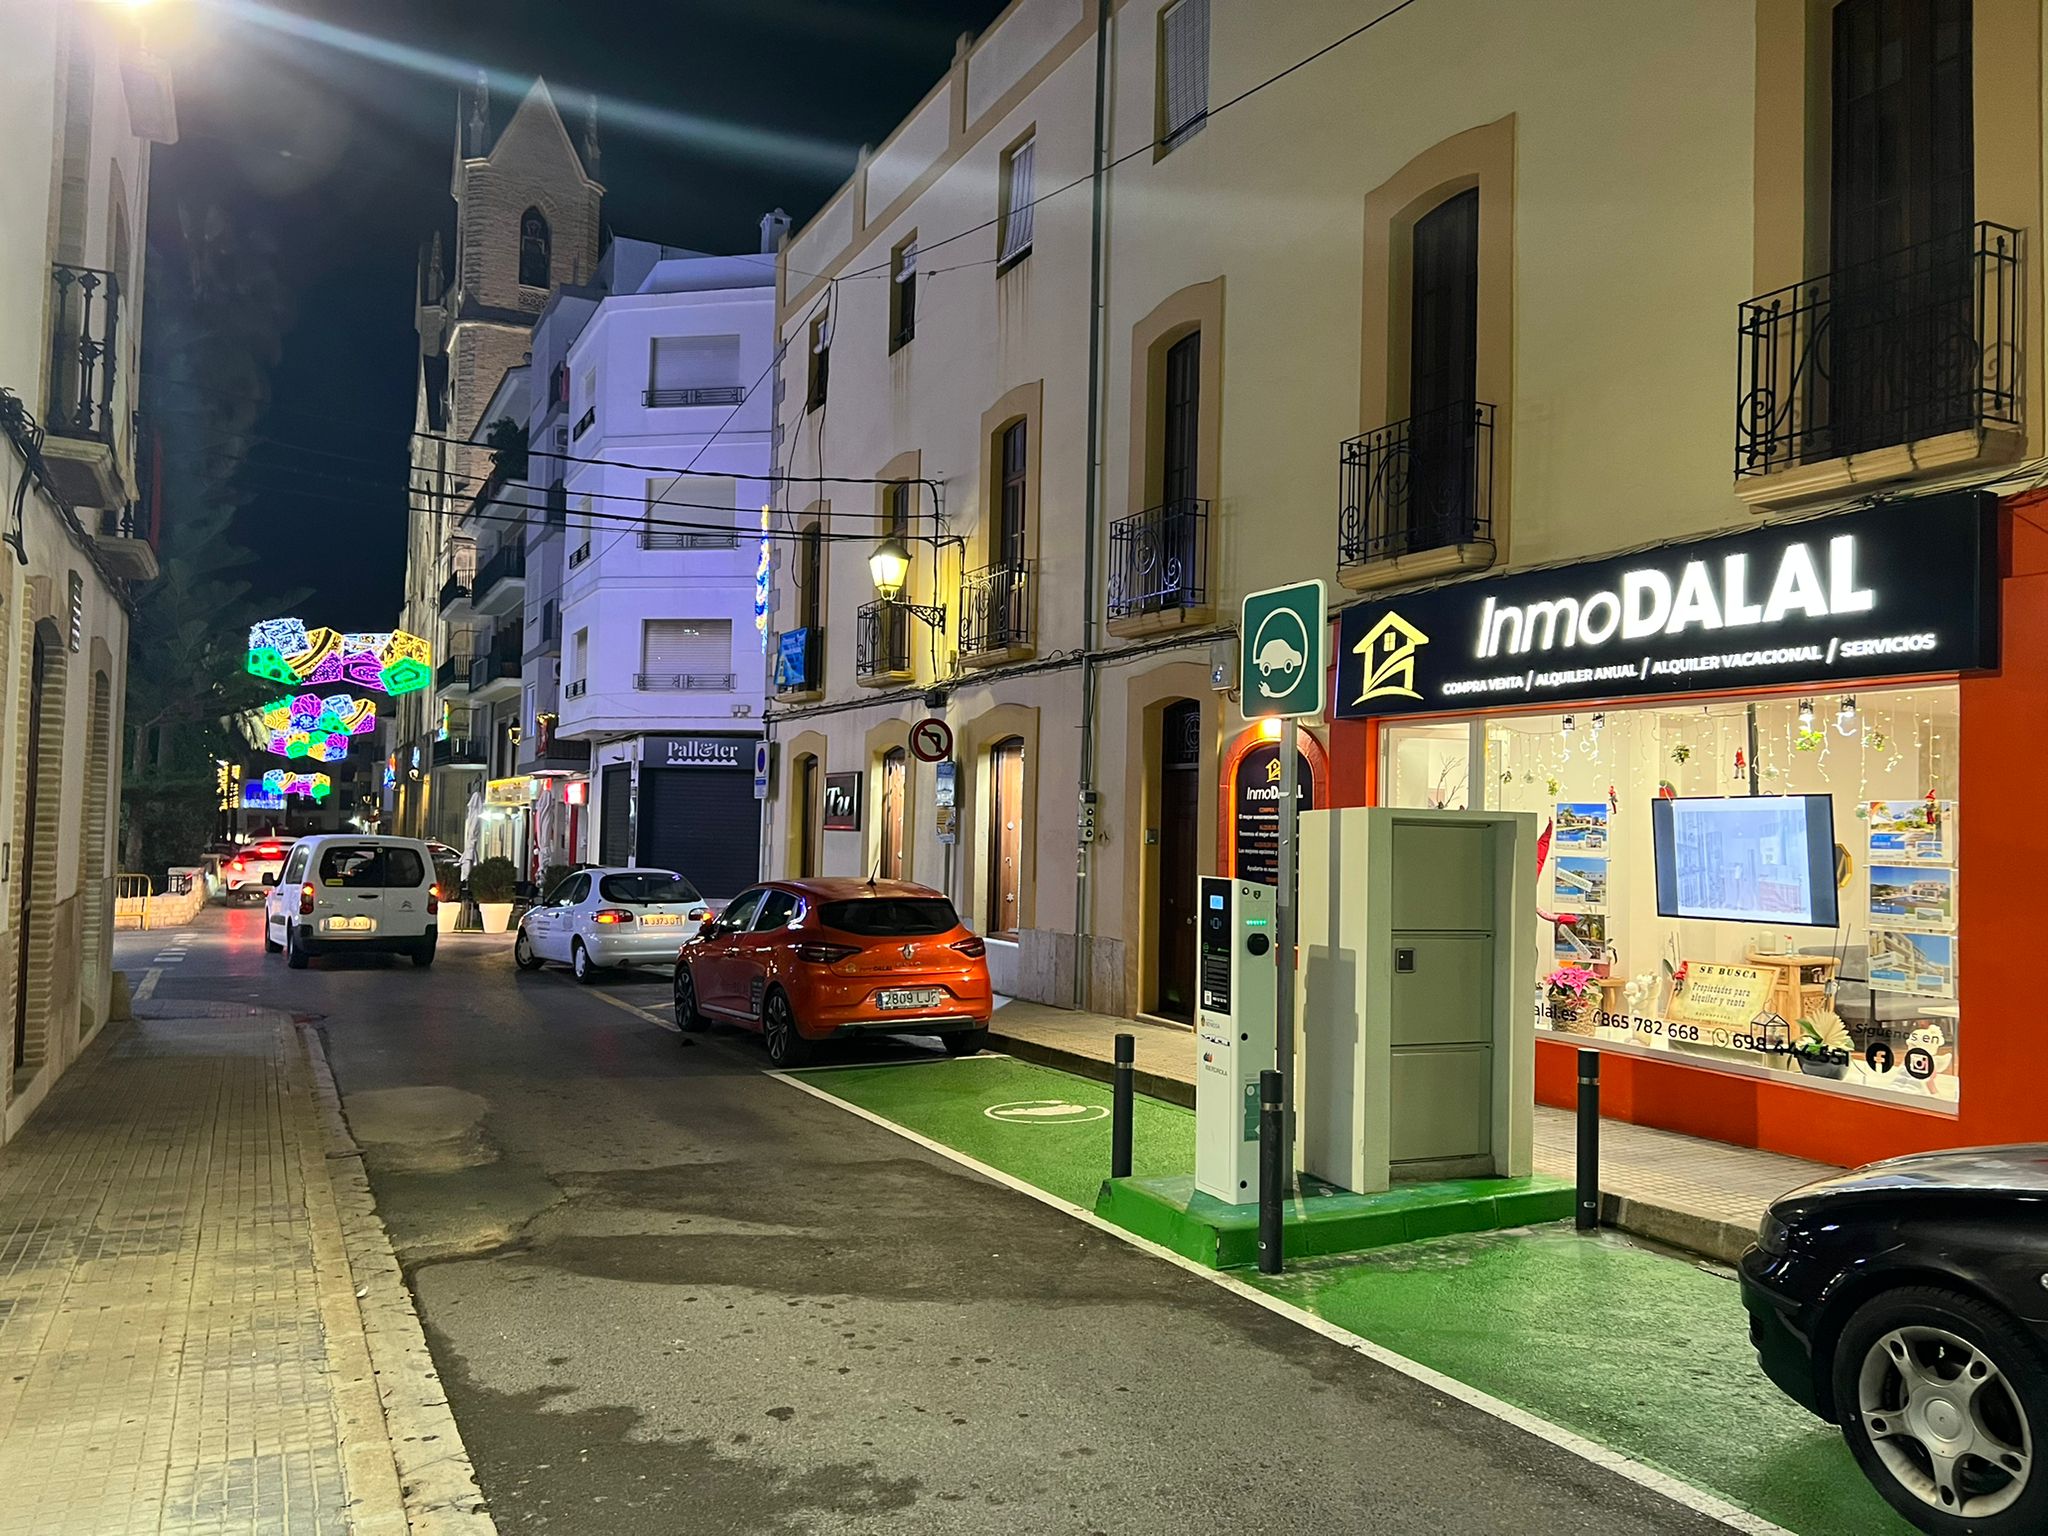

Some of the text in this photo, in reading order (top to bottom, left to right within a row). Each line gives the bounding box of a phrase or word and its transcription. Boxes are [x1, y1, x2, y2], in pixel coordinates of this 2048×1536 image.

[1477, 536, 1874, 658] InmoDALAL
[1443, 682, 1486, 696] COMPRA
[1487, 675, 1524, 692] VENTA
[1535, 668, 1592, 687] ALQUILER
[1593, 664, 1638, 682] ANUAL
[1651, 655, 1721, 677] ALQUILER
[1722, 646, 1821, 669] VACACIONAL
[1839, 633, 1936, 659] SERVICIOS
[826, 787, 850, 816] Tu
[1246, 784, 1304, 800] InmoDL
[1699, 965, 1757, 979] SE BUSCA
[1601, 1013, 1629, 1030] 865
[1634, 1018, 1663, 1035] 782
[1668, 1023, 1699, 1041] 668
[1733, 1033, 1767, 1052] 698
[1922, 1033, 1940, 1044] en
